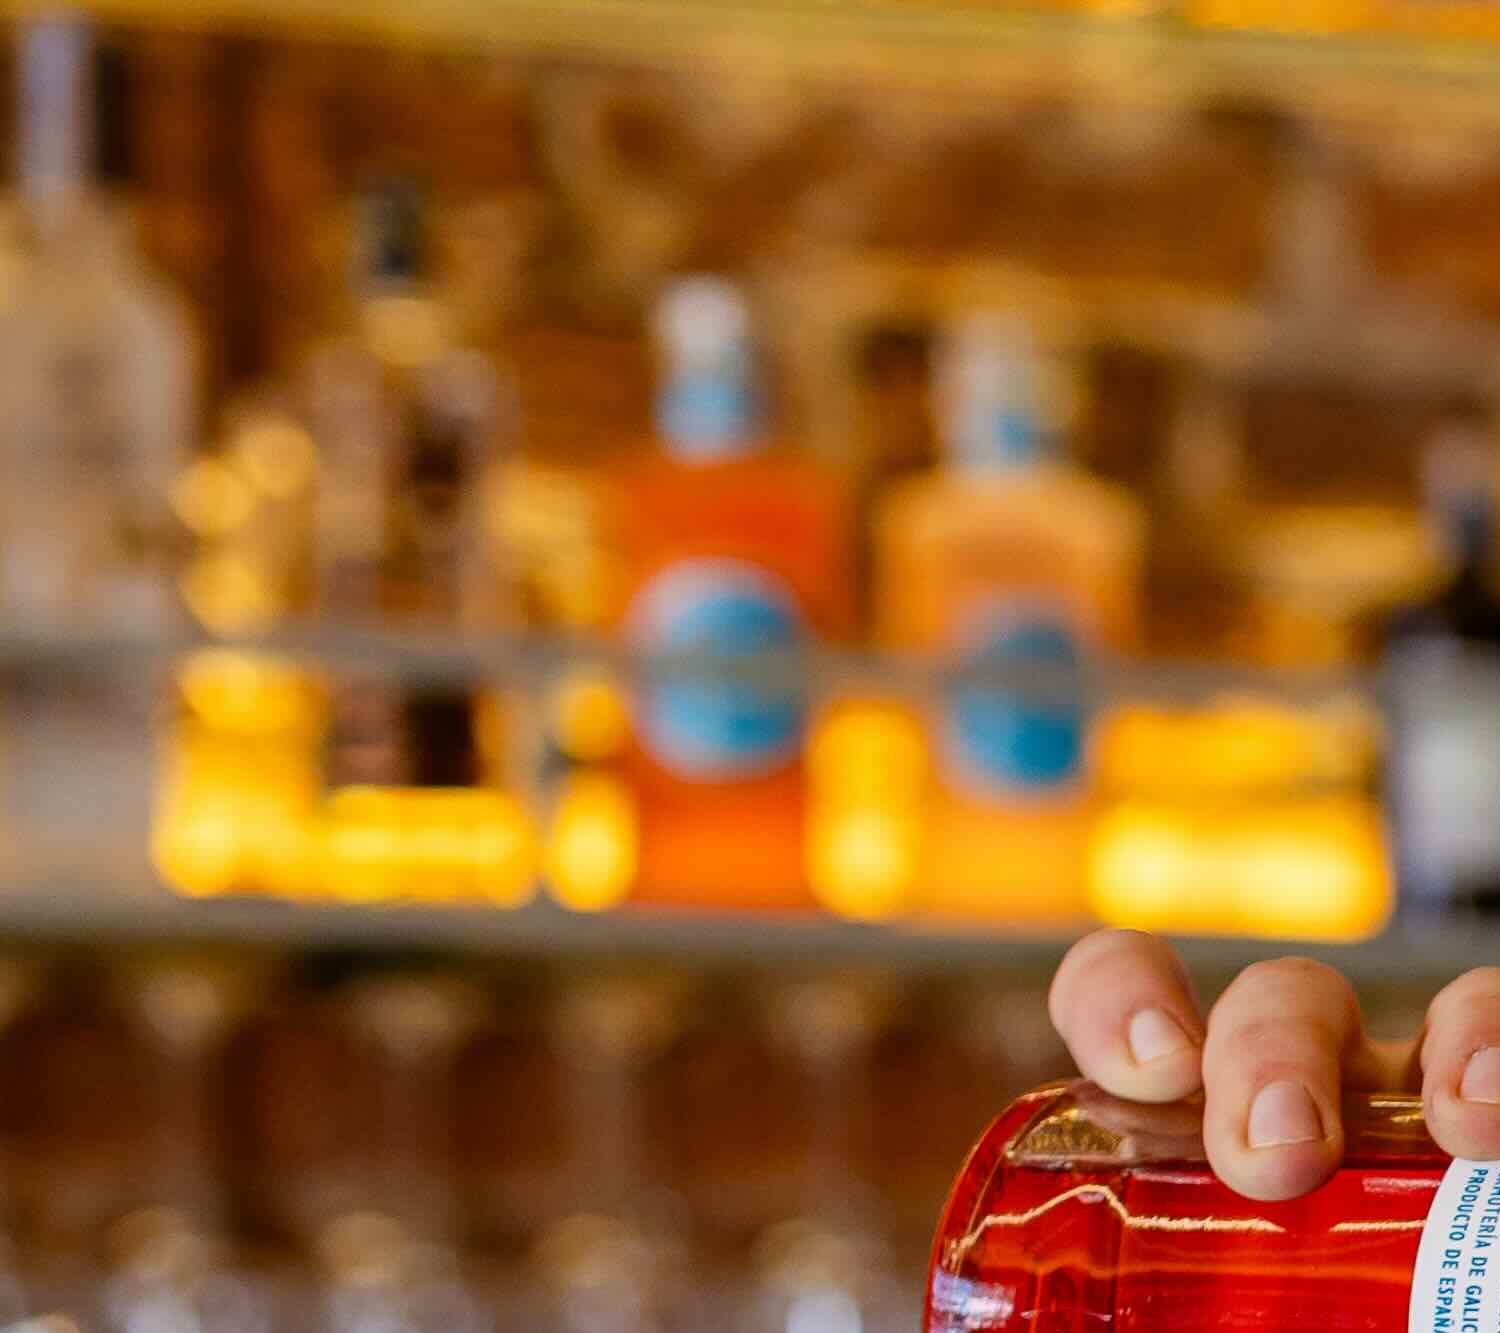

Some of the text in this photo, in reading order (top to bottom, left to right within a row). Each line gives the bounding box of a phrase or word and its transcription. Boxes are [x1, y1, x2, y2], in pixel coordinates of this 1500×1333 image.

[1448, 1167, 1490, 1243] PRODUCTO
[1440, 1248, 1462, 1271] DE
[1467, 1255, 1489, 1278] DE
